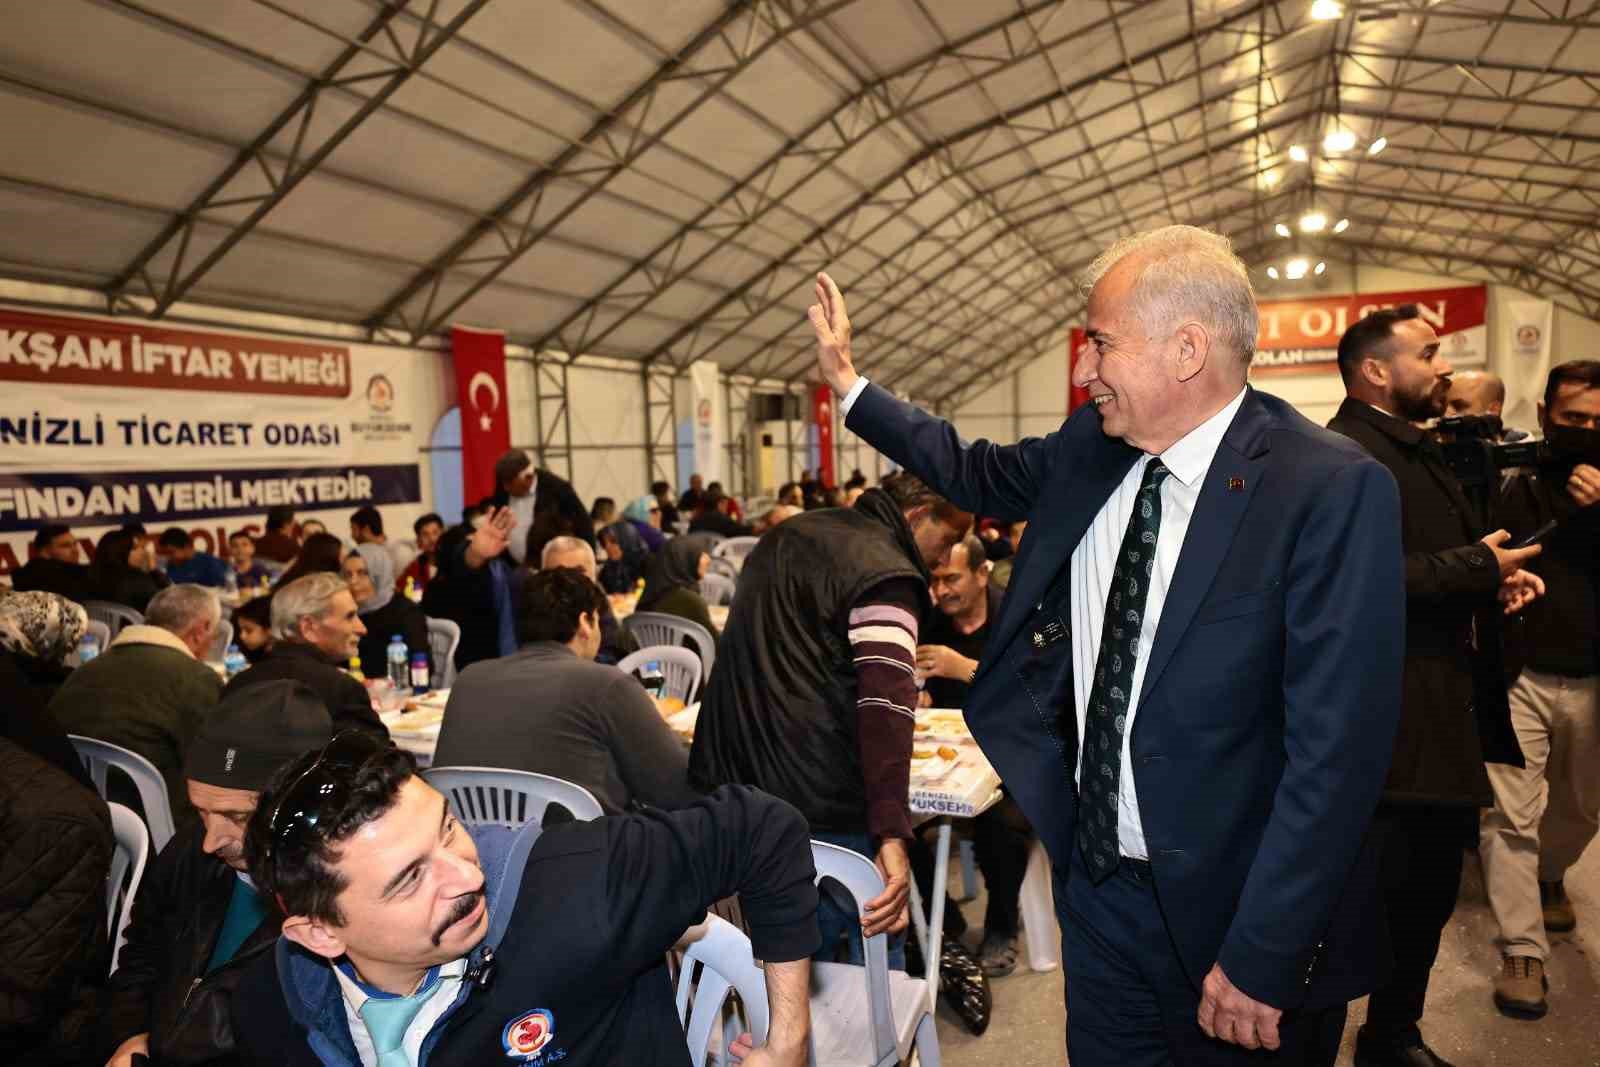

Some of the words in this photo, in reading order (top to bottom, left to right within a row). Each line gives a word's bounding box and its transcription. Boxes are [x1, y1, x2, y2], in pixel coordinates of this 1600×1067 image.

[131, 333, 233, 379] İFTAR
[239, 350, 346, 387] YEMEĞİ
[1250, 348, 1303, 366] OLAN
[0, 411, 103, 446] NİZLİ
[117, 413, 253, 446] TİCARET
[264, 423, 340, 446] ODASI
[147, 469, 373, 513] VERİLMEKTEDİR
